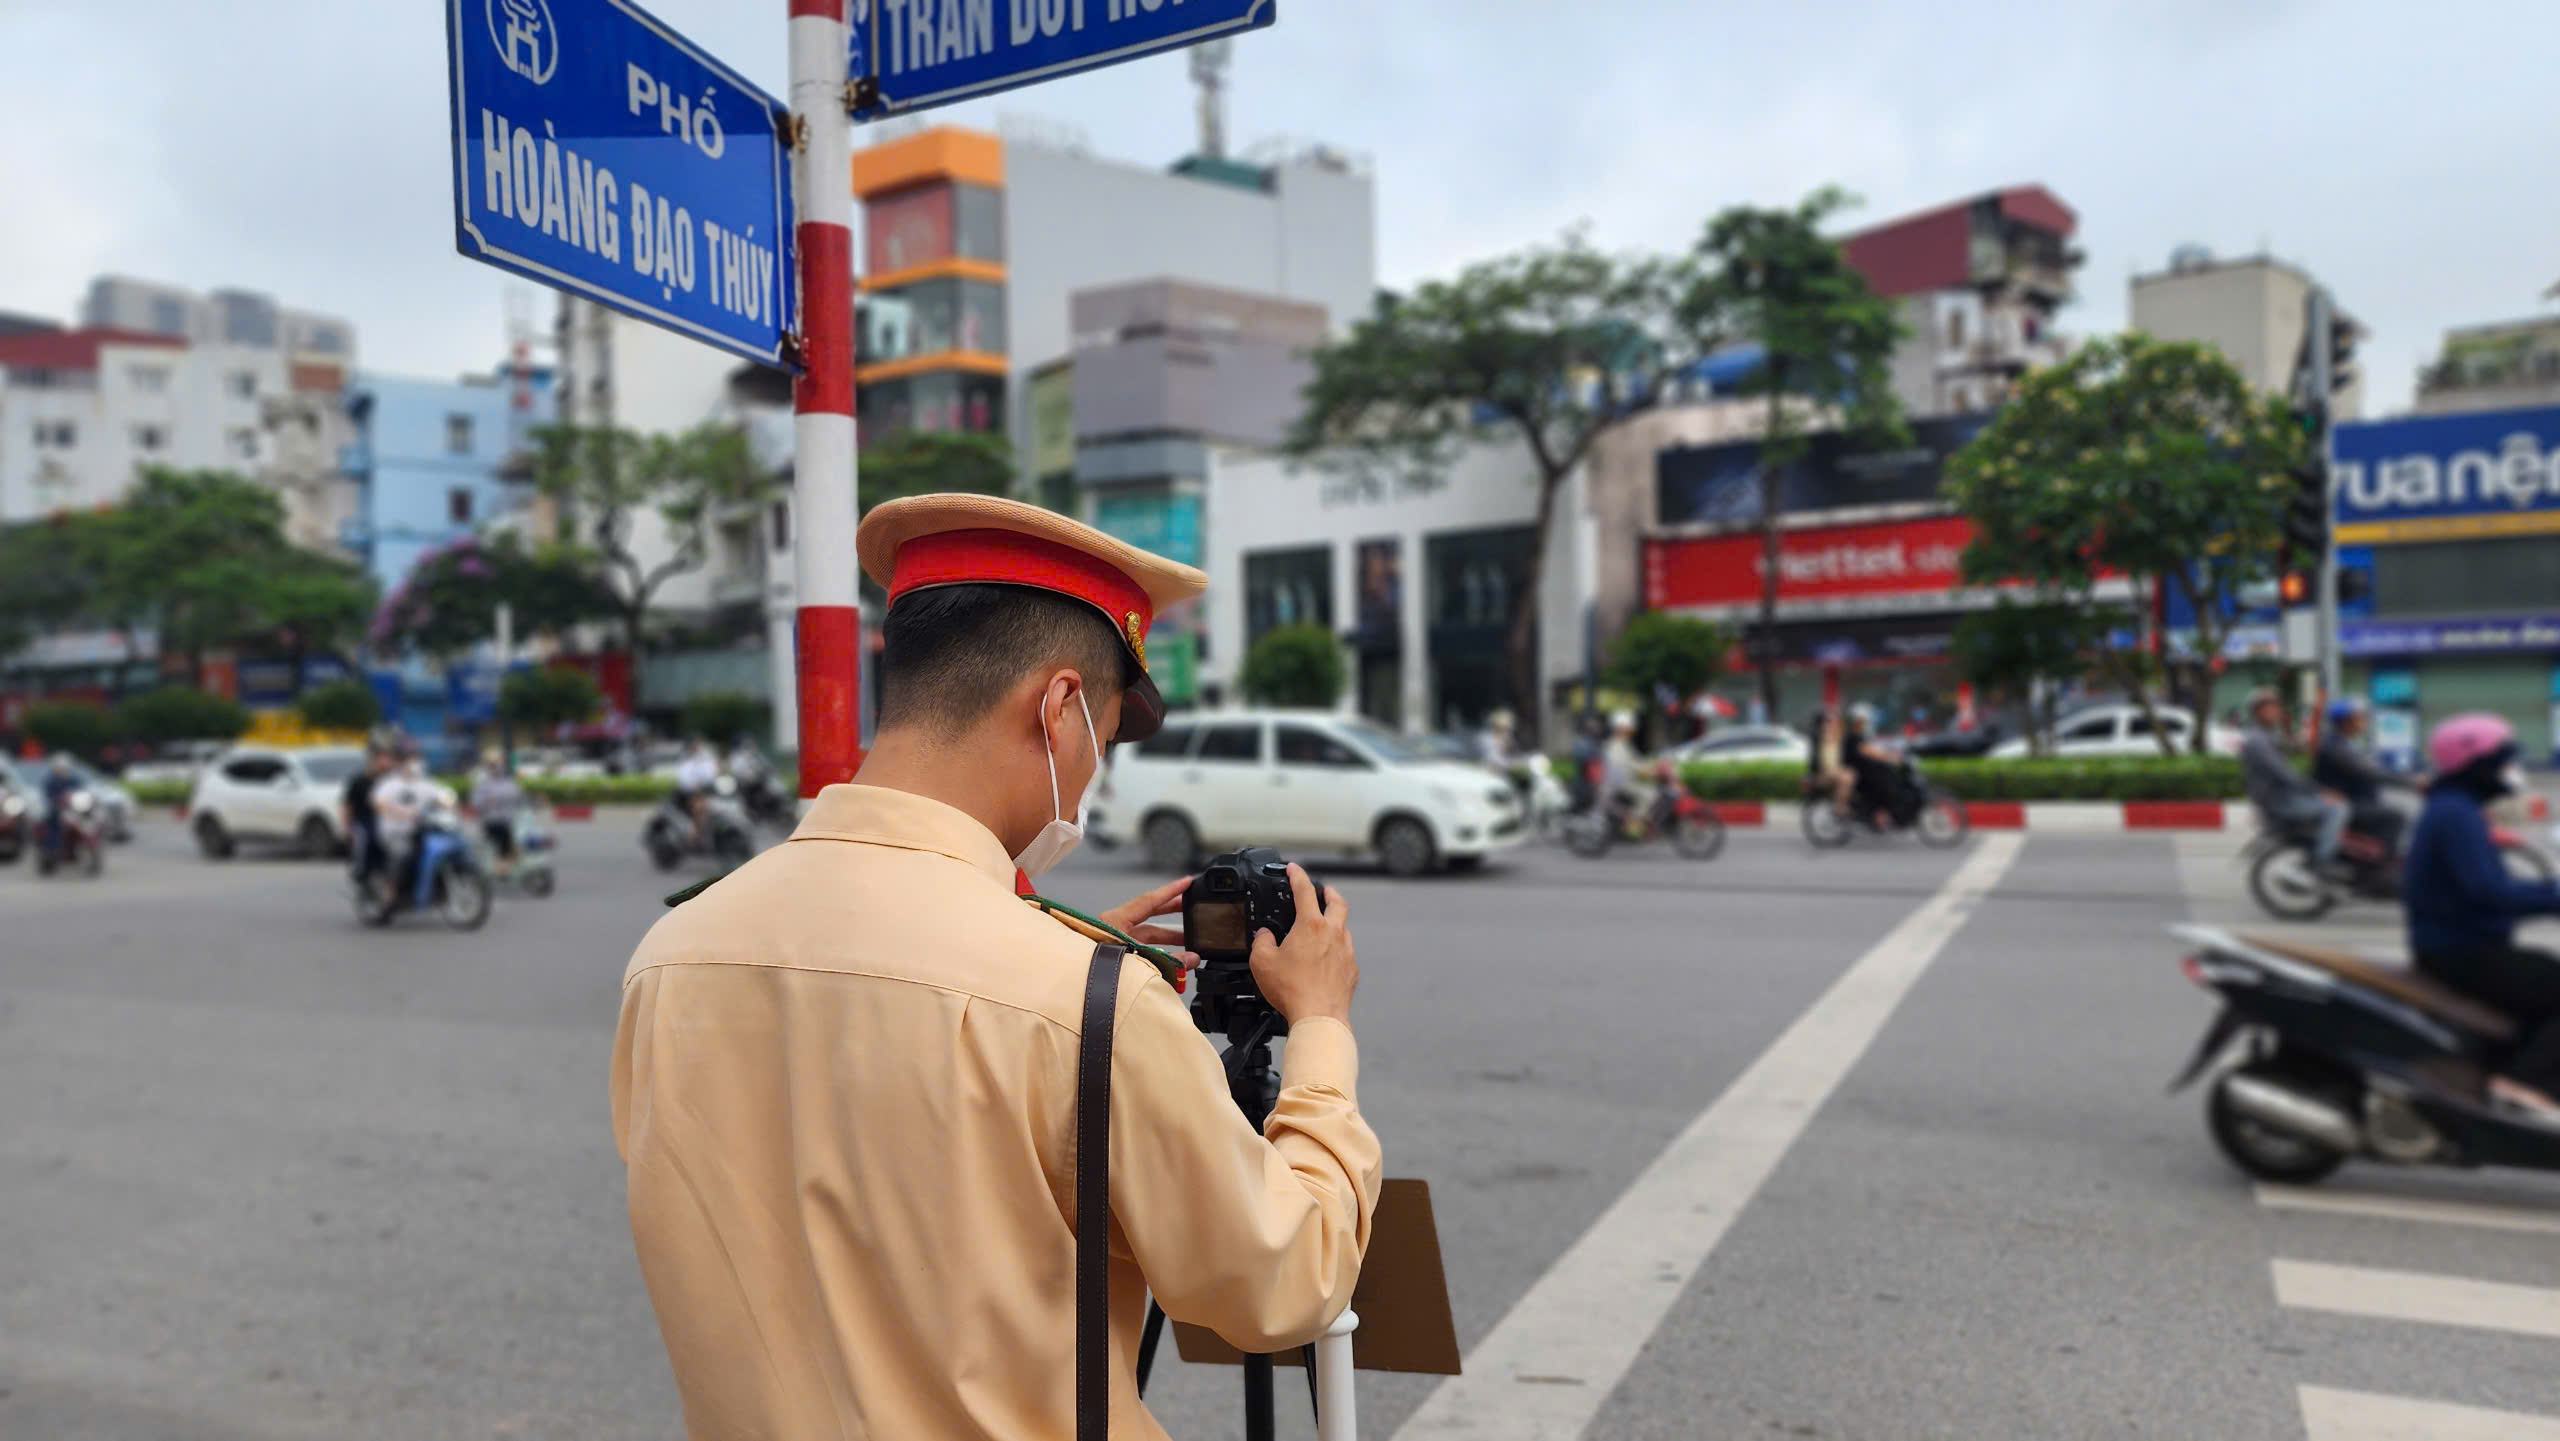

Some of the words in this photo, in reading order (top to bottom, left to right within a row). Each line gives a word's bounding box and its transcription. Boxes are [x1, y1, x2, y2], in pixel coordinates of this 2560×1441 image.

[627, 61, 725, 159] PHỐ
[482, 107, 620, 264] HOÀNG
[630, 182, 695, 301] ĐẠO
[704, 219, 773, 328] THÚY
